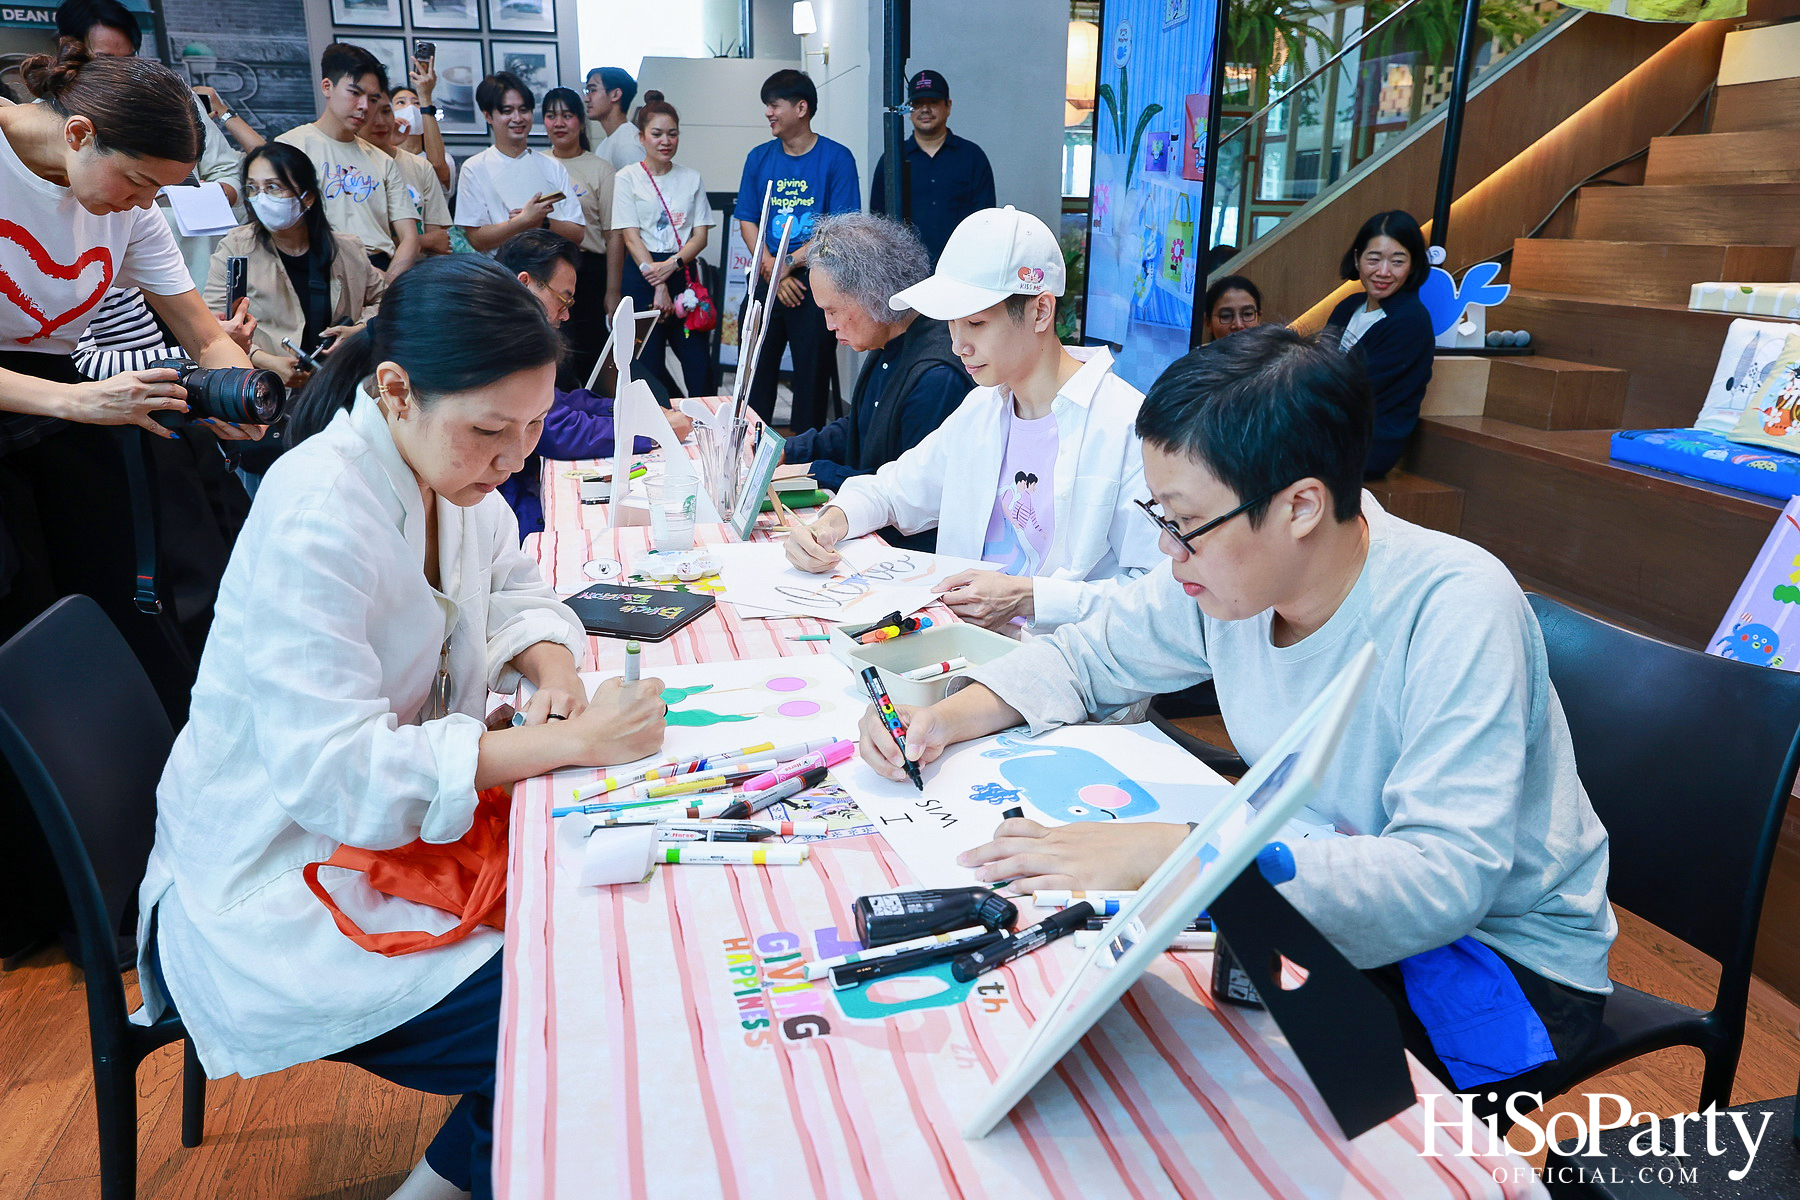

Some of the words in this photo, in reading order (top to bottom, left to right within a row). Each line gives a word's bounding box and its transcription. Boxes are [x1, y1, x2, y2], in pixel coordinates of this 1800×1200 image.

[2, 9, 49, 22] DEAN
[776, 178, 808, 193] giving
[723, 937, 774, 1048] HAPPINESS
[756, 931, 831, 1041] GIVING
